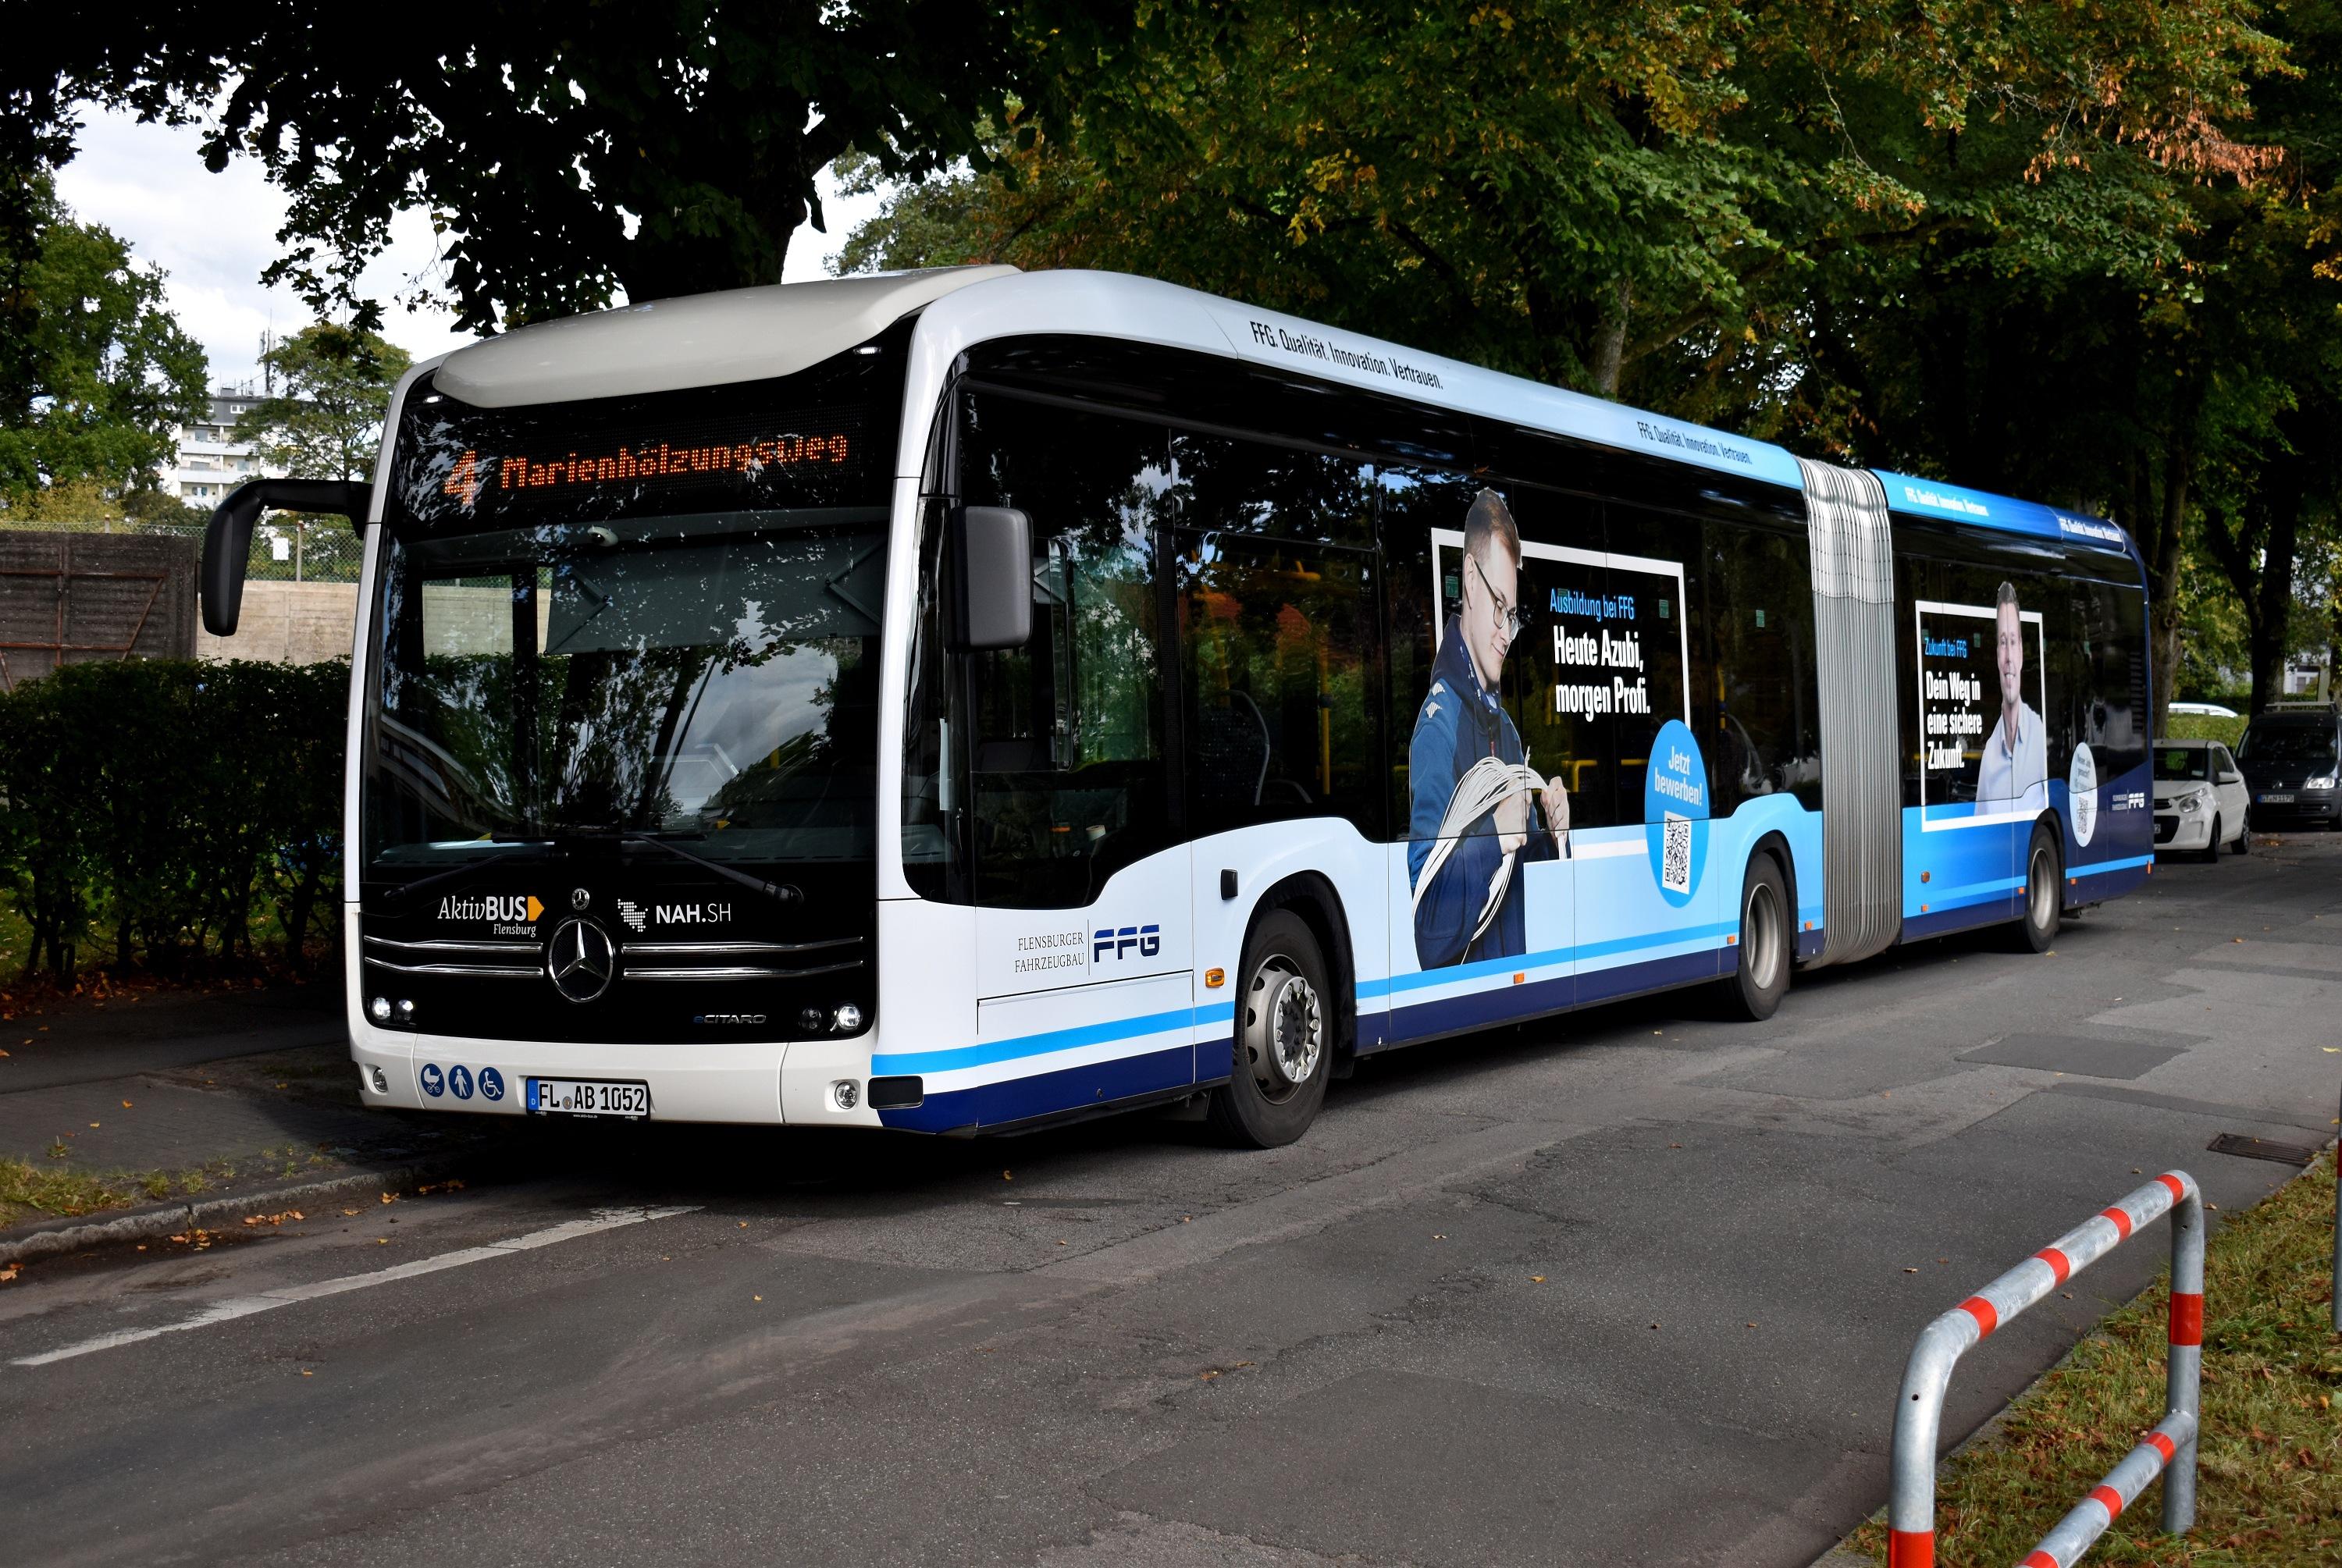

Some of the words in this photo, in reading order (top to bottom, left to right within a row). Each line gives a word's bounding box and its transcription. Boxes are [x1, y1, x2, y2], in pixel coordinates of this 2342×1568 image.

[1249, 321, 1279, 348] FFG.
[1279, 328, 1330, 361] Qualität.
[1329, 341, 1391, 377] Innovation.
[1388, 357, 1443, 389] Vertrauen.
[444, 450, 477, 504] 4
[502, 435, 847, 489] Marienhölzungsweg
[1550, 588, 1602, 622] Ausbildung
[1603, 595, 1617, 617] bei
[1618, 597, 1635, 620] FFG
[1554, 625, 1598, 666] Heute
[1601, 629, 1643, 672] Azubi,
[1556, 684, 1611, 722] morgen
[1614, 676, 1651, 713] Profi.
[1926, 670, 1949, 699] Dein
[1949, 672, 1971, 706] Weg
[1970, 673, 1981, 700] in
[1927, 706, 1949, 734] eine
[1949, 706, 1983, 734] sichere
[1668, 745, 1690, 775] Jetzt
[1927, 741, 1965, 770] Zukunft.
[1654, 766, 1703, 806] bewerben!
[437, 896, 528, 922] AktivBUS
[656, 903, 731, 924] NAH.SH
[493, 923, 537, 938] Flensburg
[1018, 932, 1084, 951] FLENSBURGER
[1094, 924, 1160, 963] FFG
[1015, 952, 1085, 973] FAHRZEUGBAU
[539, 1083, 561, 1108] FL
[574, 1085, 596, 1110] AB
[600, 1086, 645, 1112] 1052
